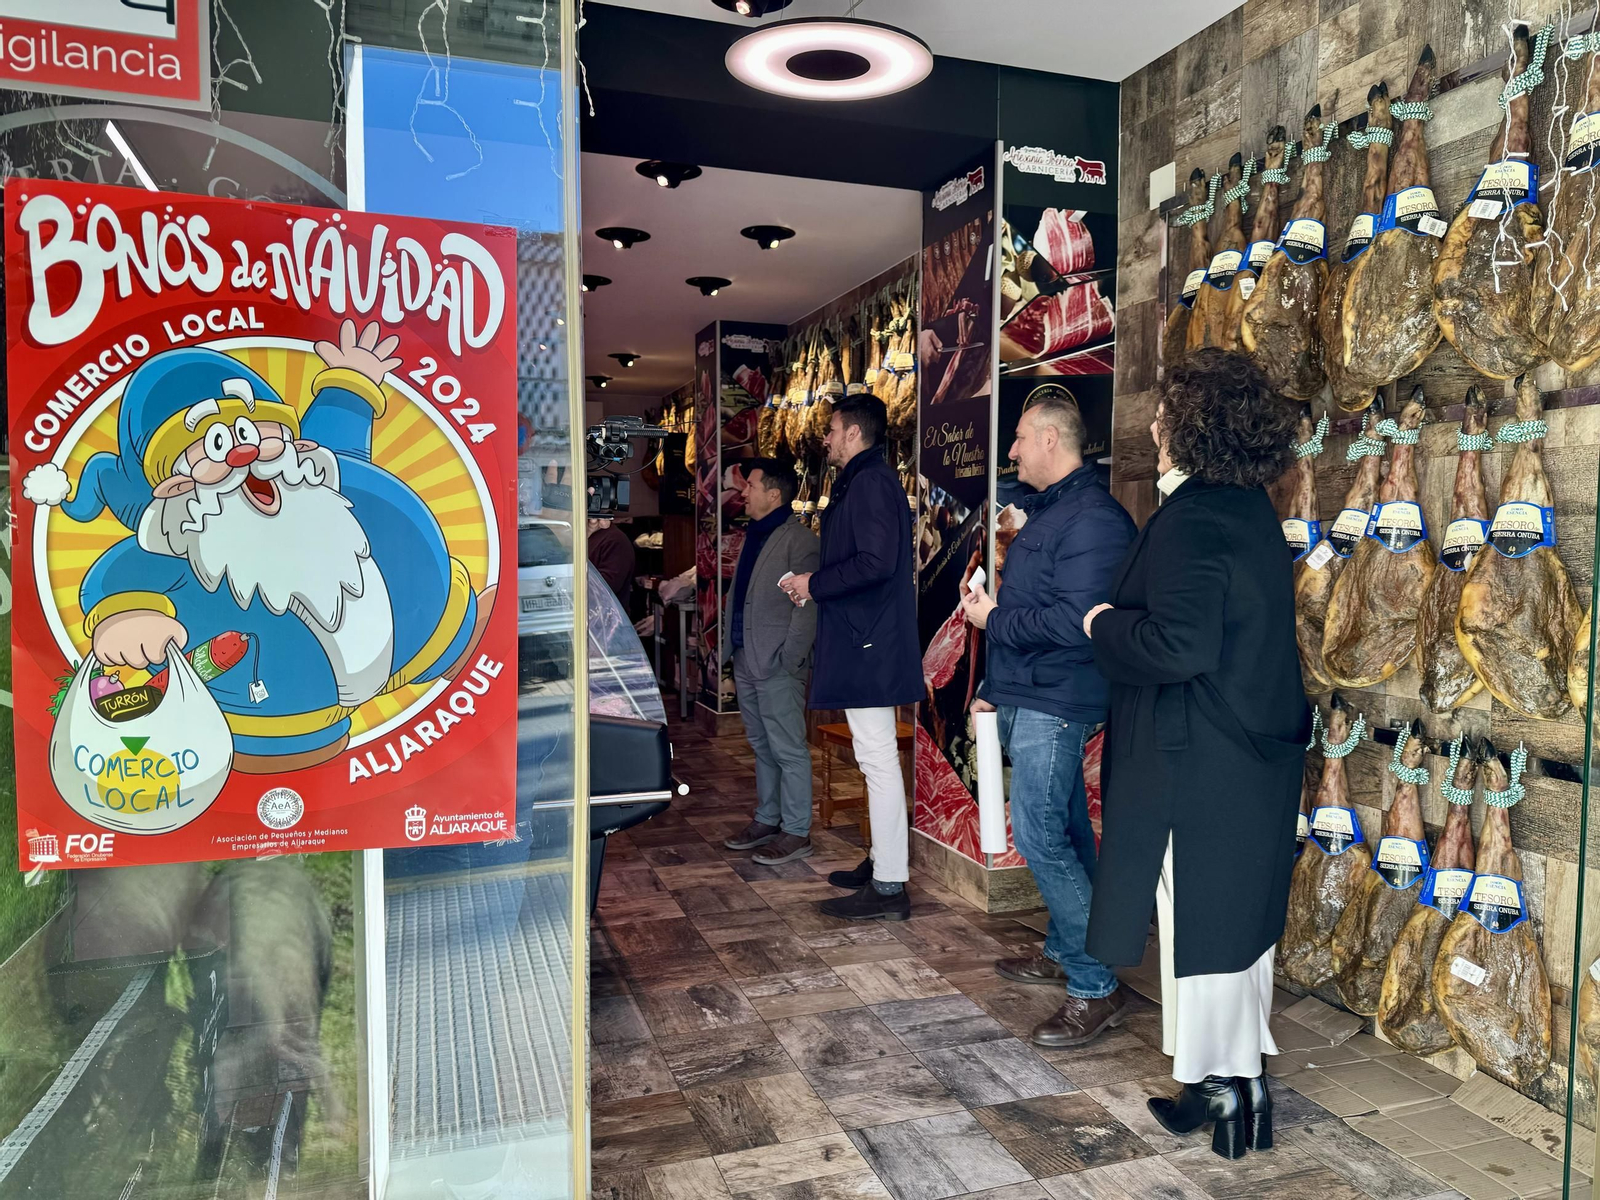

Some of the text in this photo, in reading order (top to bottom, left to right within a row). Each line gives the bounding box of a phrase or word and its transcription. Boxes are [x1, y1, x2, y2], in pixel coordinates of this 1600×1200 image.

[0, 24, 182, 81] igilancia
[1482, 178, 1521, 188] TESORO
[1478, 188, 1501, 197] SIERRA
[1399, 202, 1434, 215] TESORO
[1401, 214, 1422, 223] SIERRA
[1289, 231, 1317, 245] TESORO
[20, 195, 505, 357] BONOS de NAVIDAD
[23, 307, 264, 453] COMERCIO LOCAL
[409, 356, 497, 446] 2024
[923, 421, 974, 449] El Sabor de
[554, 490, 571, 499] SON
[1381, 517, 1416, 528] TESORO
[1495, 520, 1535, 531] TESORO
[1401, 529, 1421, 537] ONUBA
[1516, 531, 1541, 540] ONUBA
[1443, 535, 1477, 548] TESORO
[1443, 547, 1460, 555] SIERRA
[100, 691, 148, 711] TURRÓN
[350, 654, 504, 784] ALJARAQUE
[74, 744, 199, 782] COMERCIO
[84, 784, 195, 813] LOCAL
[271, 801, 291, 810] AeA
[433, 810, 505, 823] Ayuntamiento de
[430, 820, 508, 836] ALJARAQUE
[1316, 820, 1348, 833] TESORO
[216, 833, 257, 843] Asociación
[271, 830, 306, 841] Pequeños
[314, 828, 349, 836] Medianos
[65, 833, 115, 854] FOE
[291, 838, 326, 847] Aljaraque
[1380, 852, 1414, 864] TESORO
[1380, 862, 1399, 870] SIERRA
[1475, 892, 1514, 906] TESORO
[1473, 902, 1520, 916] SIERRA ONUBA
